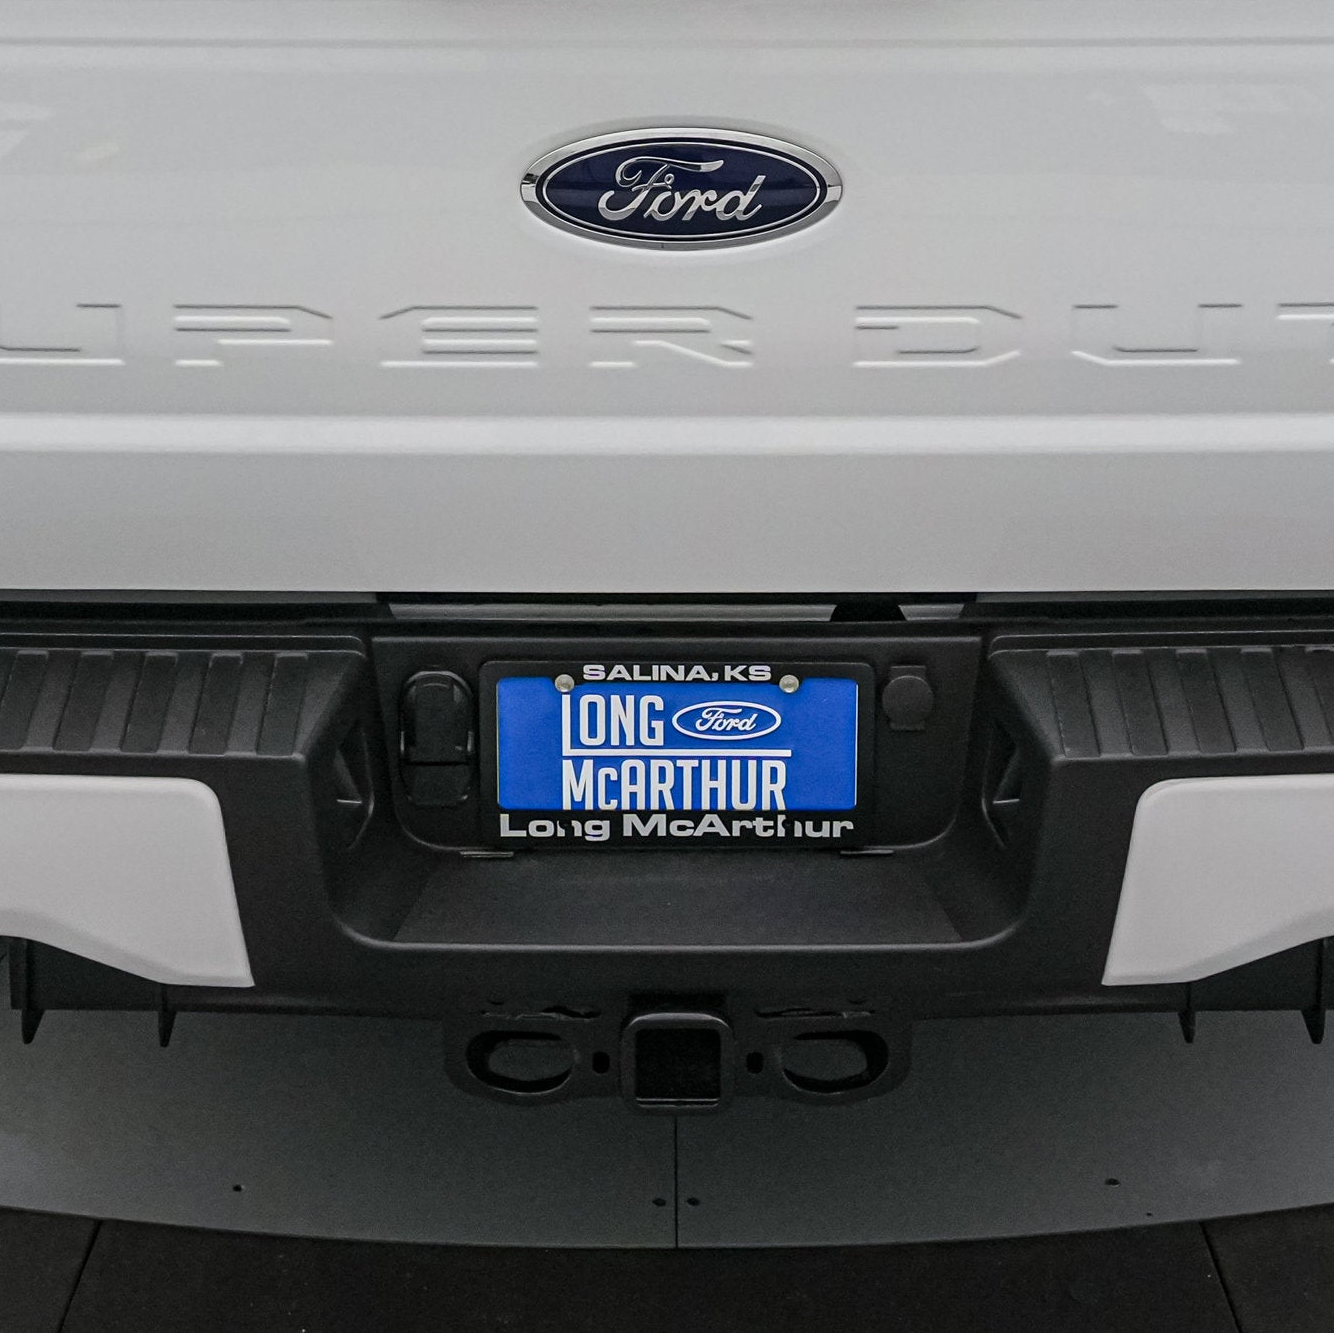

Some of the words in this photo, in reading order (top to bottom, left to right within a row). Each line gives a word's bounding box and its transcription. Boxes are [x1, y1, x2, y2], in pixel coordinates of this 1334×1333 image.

[597, 155, 766, 221] Ford
[724, 664, 772, 682] KS
[561, 694, 665, 748] LONG
[694, 706, 759, 732] Ford
[561, 758, 787, 811] McARTHUR
[499, 813, 611, 842] Long
[621, 813, 855, 838] McArthur
